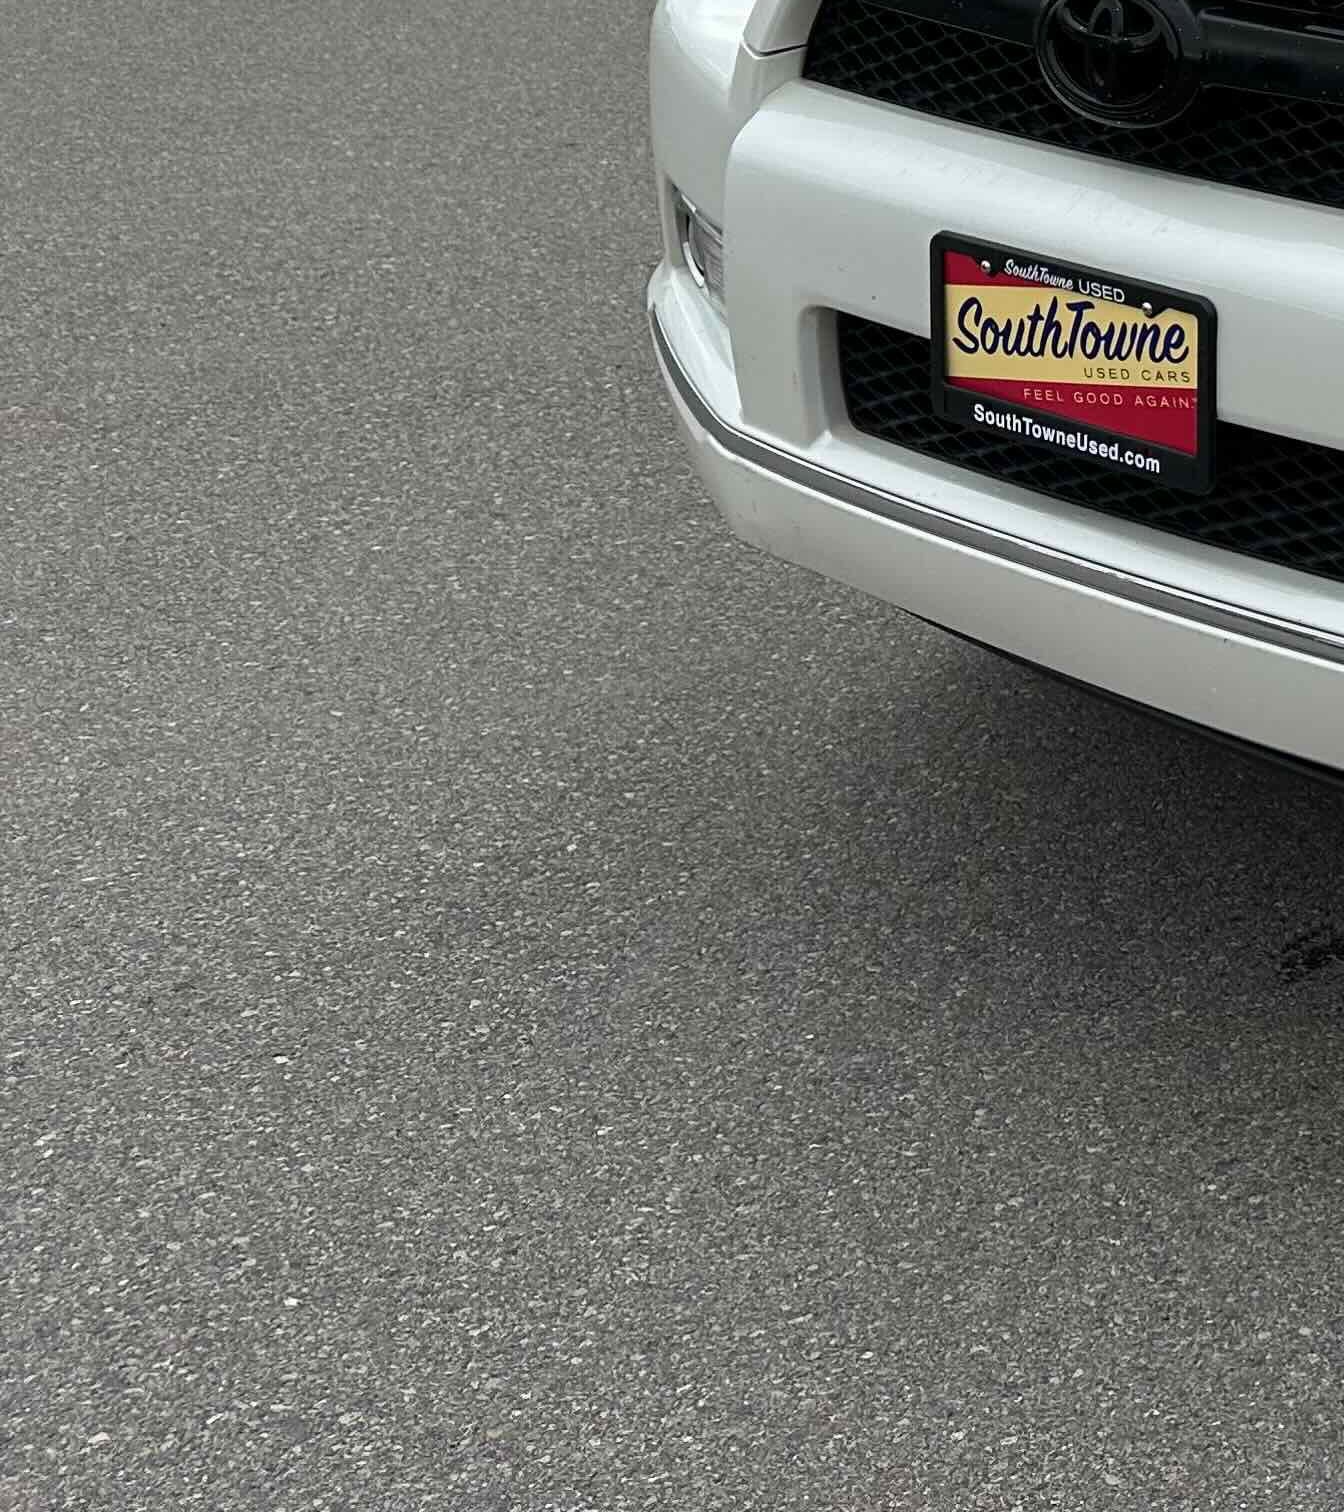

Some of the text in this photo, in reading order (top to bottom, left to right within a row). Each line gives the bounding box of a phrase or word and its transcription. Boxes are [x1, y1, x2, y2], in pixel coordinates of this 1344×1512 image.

[1003, 259, 1126, 303] SouthTowne USED
[952, 296, 1190, 364] SouthTowne
[1023, 388, 1064, 402] FEEL
[1073, 391, 1124, 406] GOOD
[1083, 367, 1191, 383] USED CARS
[973, 404, 1161, 474] SouthTowneUsed.com
